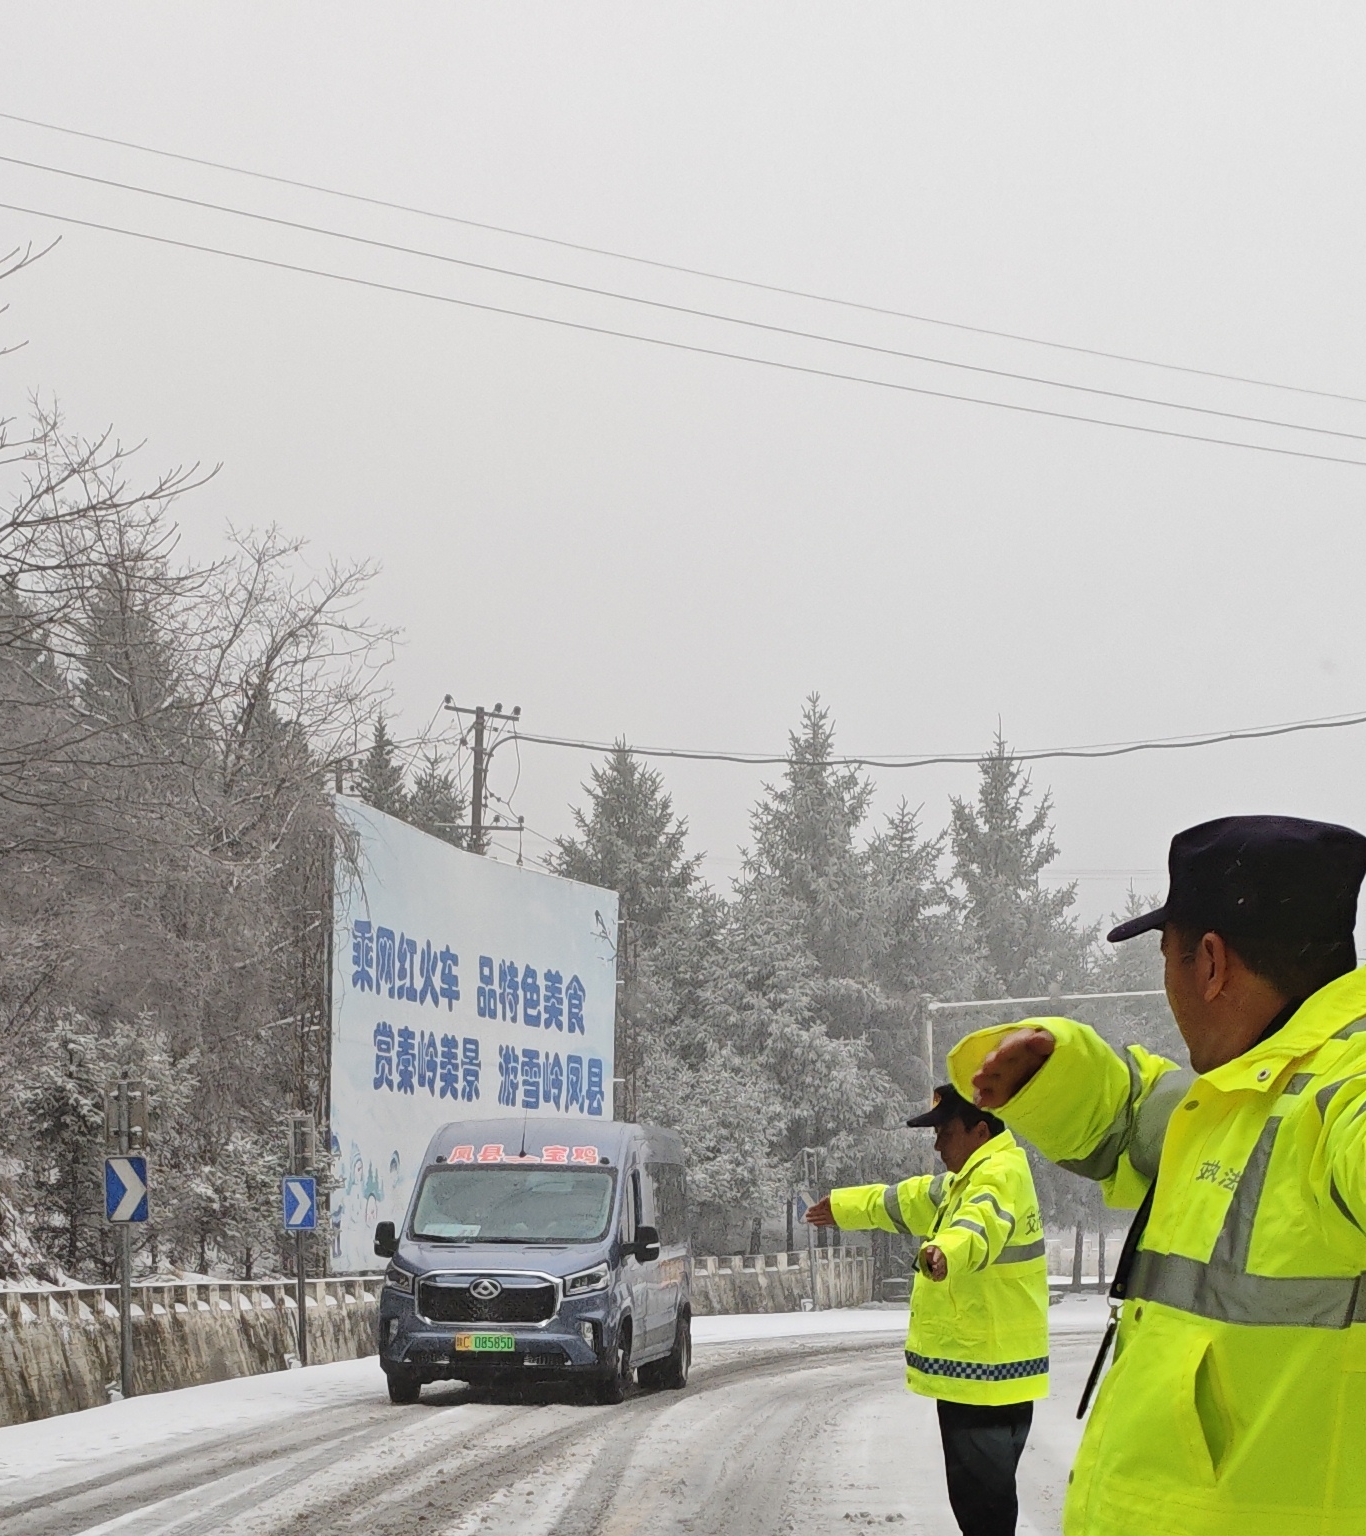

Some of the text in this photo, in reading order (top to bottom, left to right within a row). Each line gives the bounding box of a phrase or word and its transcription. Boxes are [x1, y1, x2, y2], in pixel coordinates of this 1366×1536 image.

[351, 919, 586, 1036] 乘网红火车 品特色美食
[373, 1021, 605, 1117] 赏秦岭美景 游雪岭凤县
